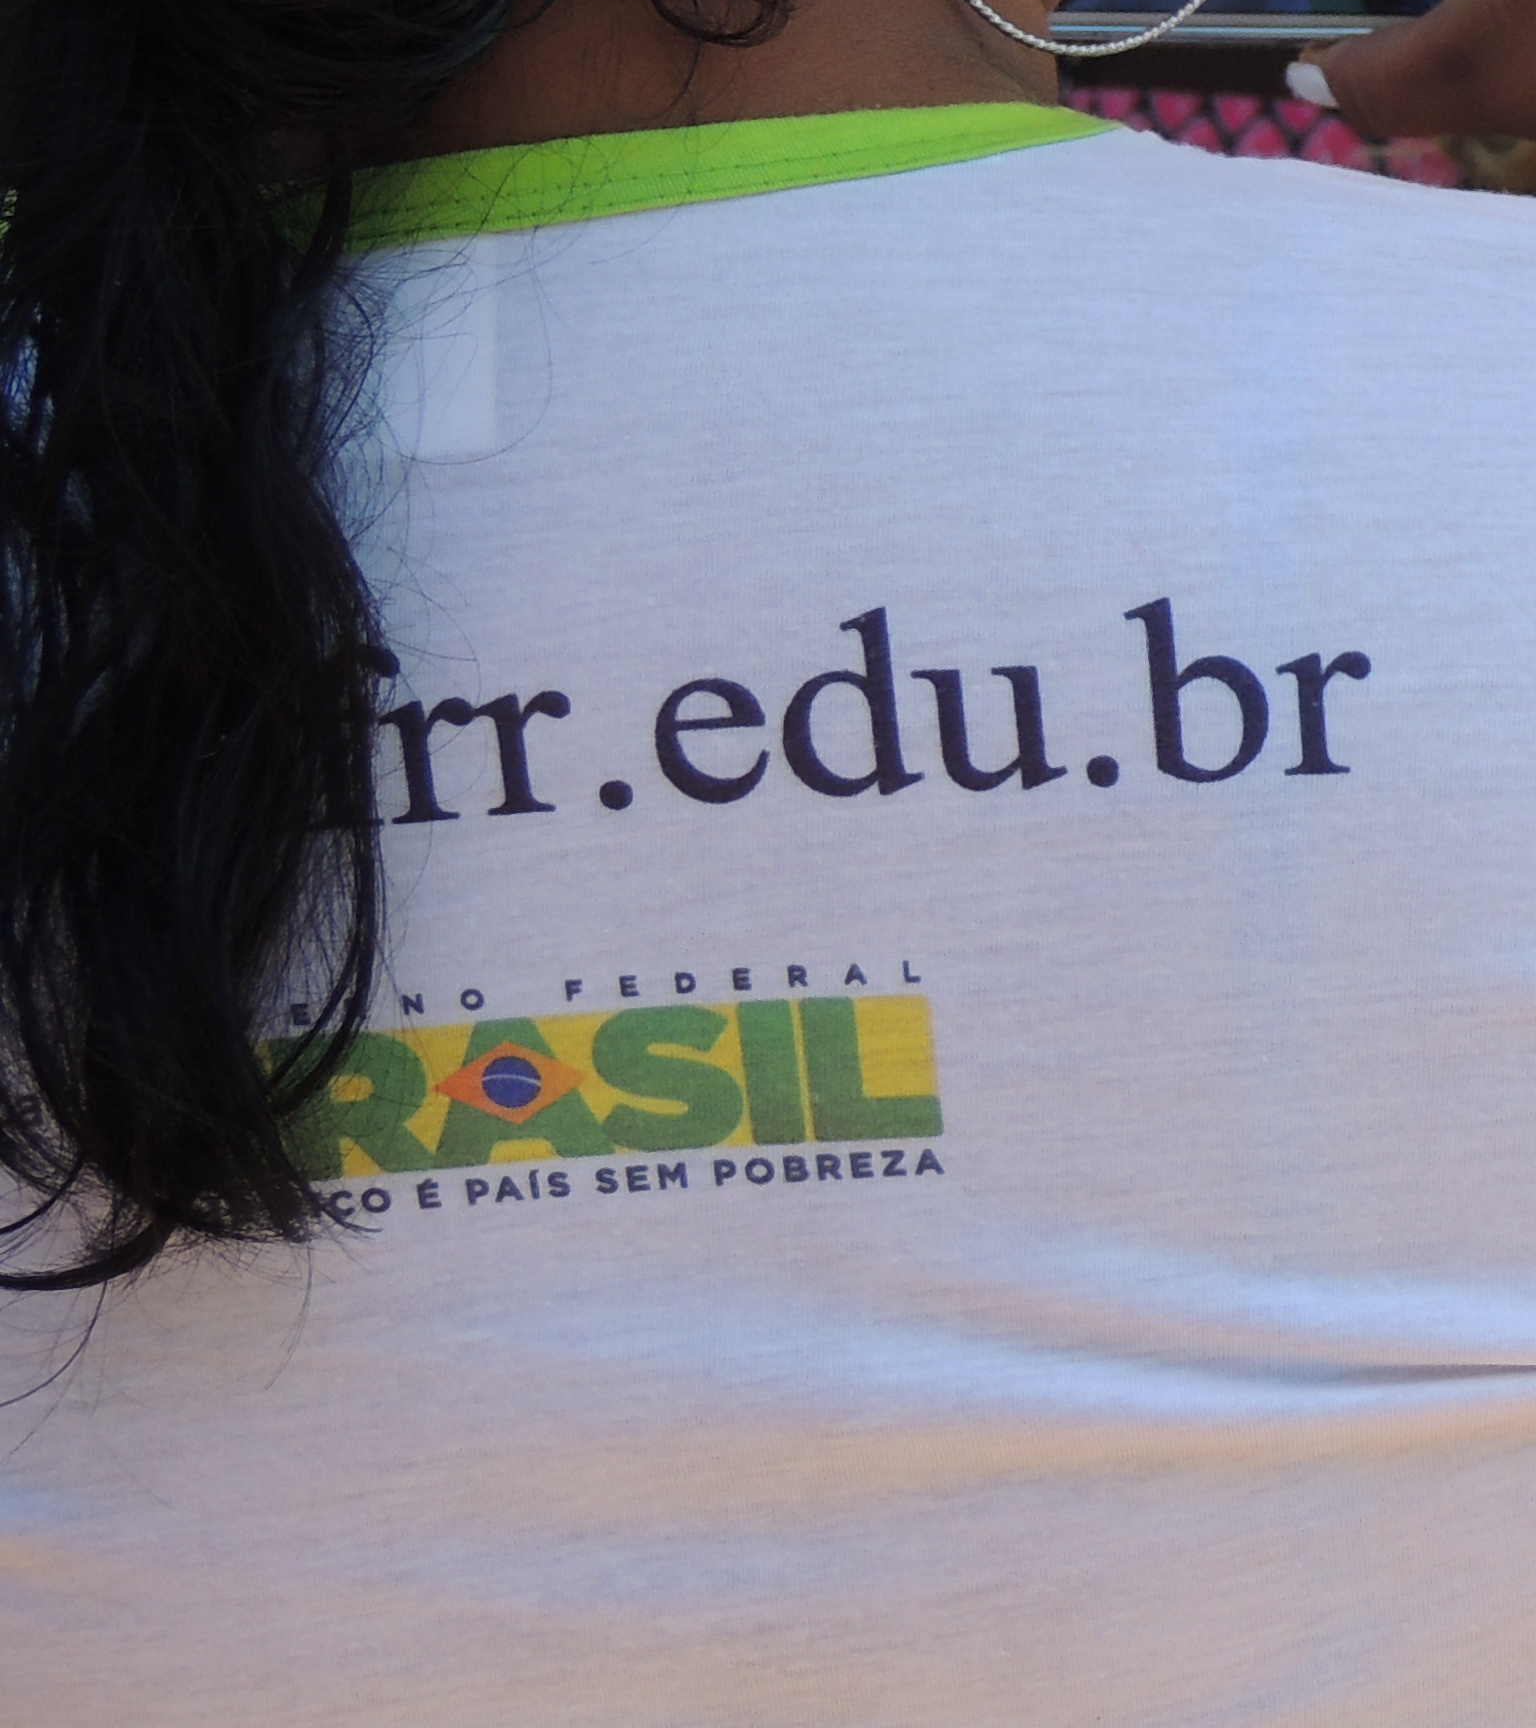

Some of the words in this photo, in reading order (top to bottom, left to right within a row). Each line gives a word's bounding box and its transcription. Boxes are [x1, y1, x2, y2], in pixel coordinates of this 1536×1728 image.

[564, 959, 922, 1003] FEDERAL
[262, 996, 944, 1182] RASIL
[416, 1177, 443, 1210] É
[464, 1169, 571, 1207] PAÍS
[595, 1162, 689, 1194] SEM
[713, 1148, 944, 1187] POBREZA
